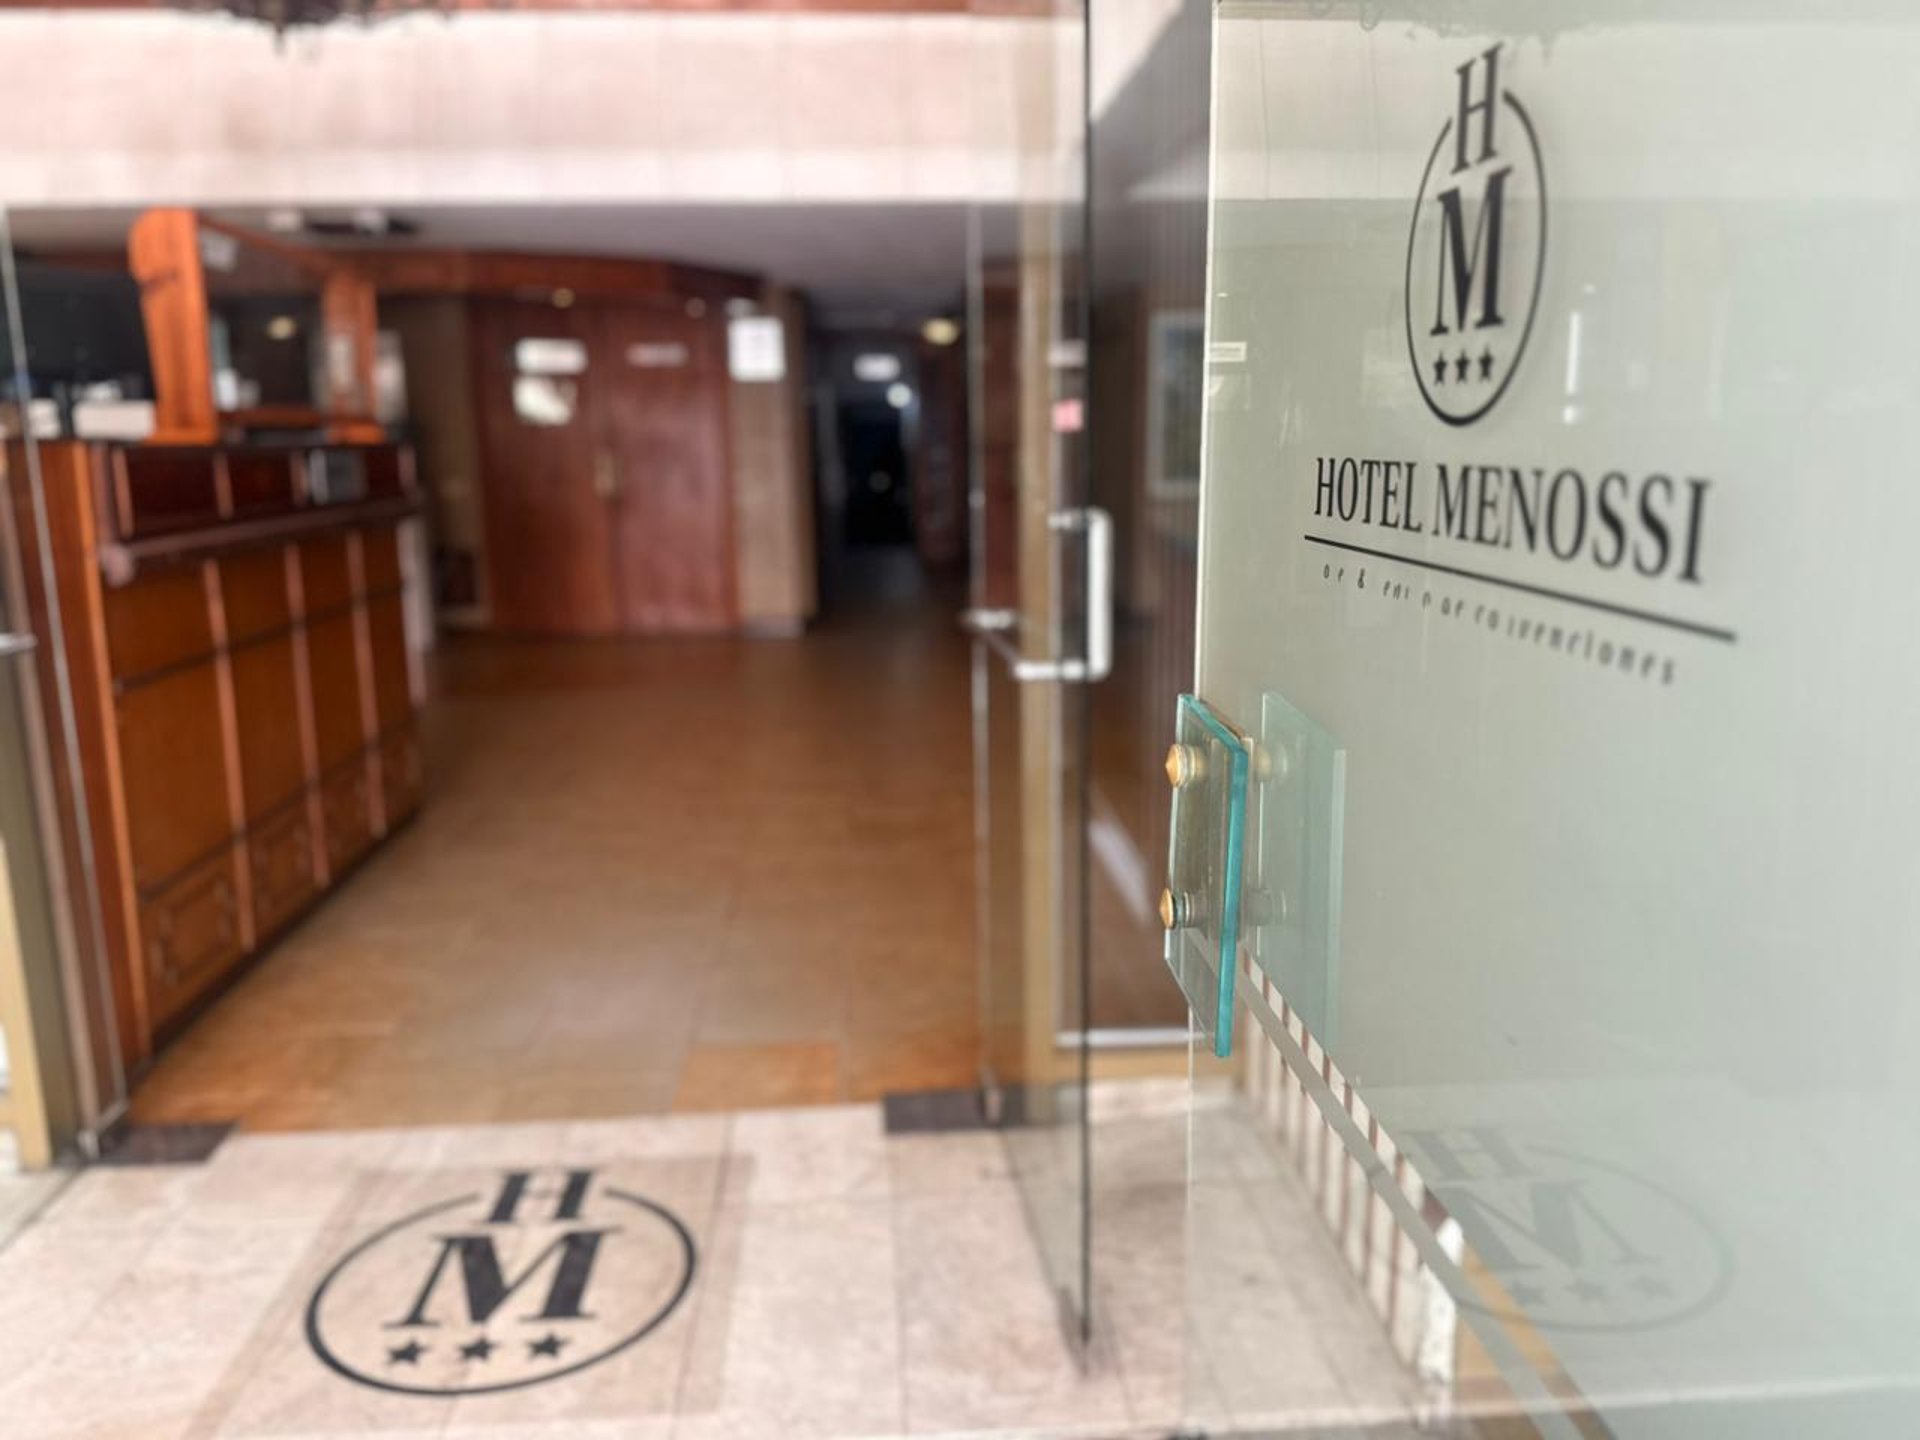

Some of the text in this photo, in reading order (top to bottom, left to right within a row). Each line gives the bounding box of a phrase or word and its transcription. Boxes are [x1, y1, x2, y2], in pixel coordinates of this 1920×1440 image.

[1451, 42, 1504, 174] H
[1430, 165, 1513, 336] M
[1314, 457, 1711, 586] HOTEL MENOSSI
[381, 1225, 625, 1329] M
